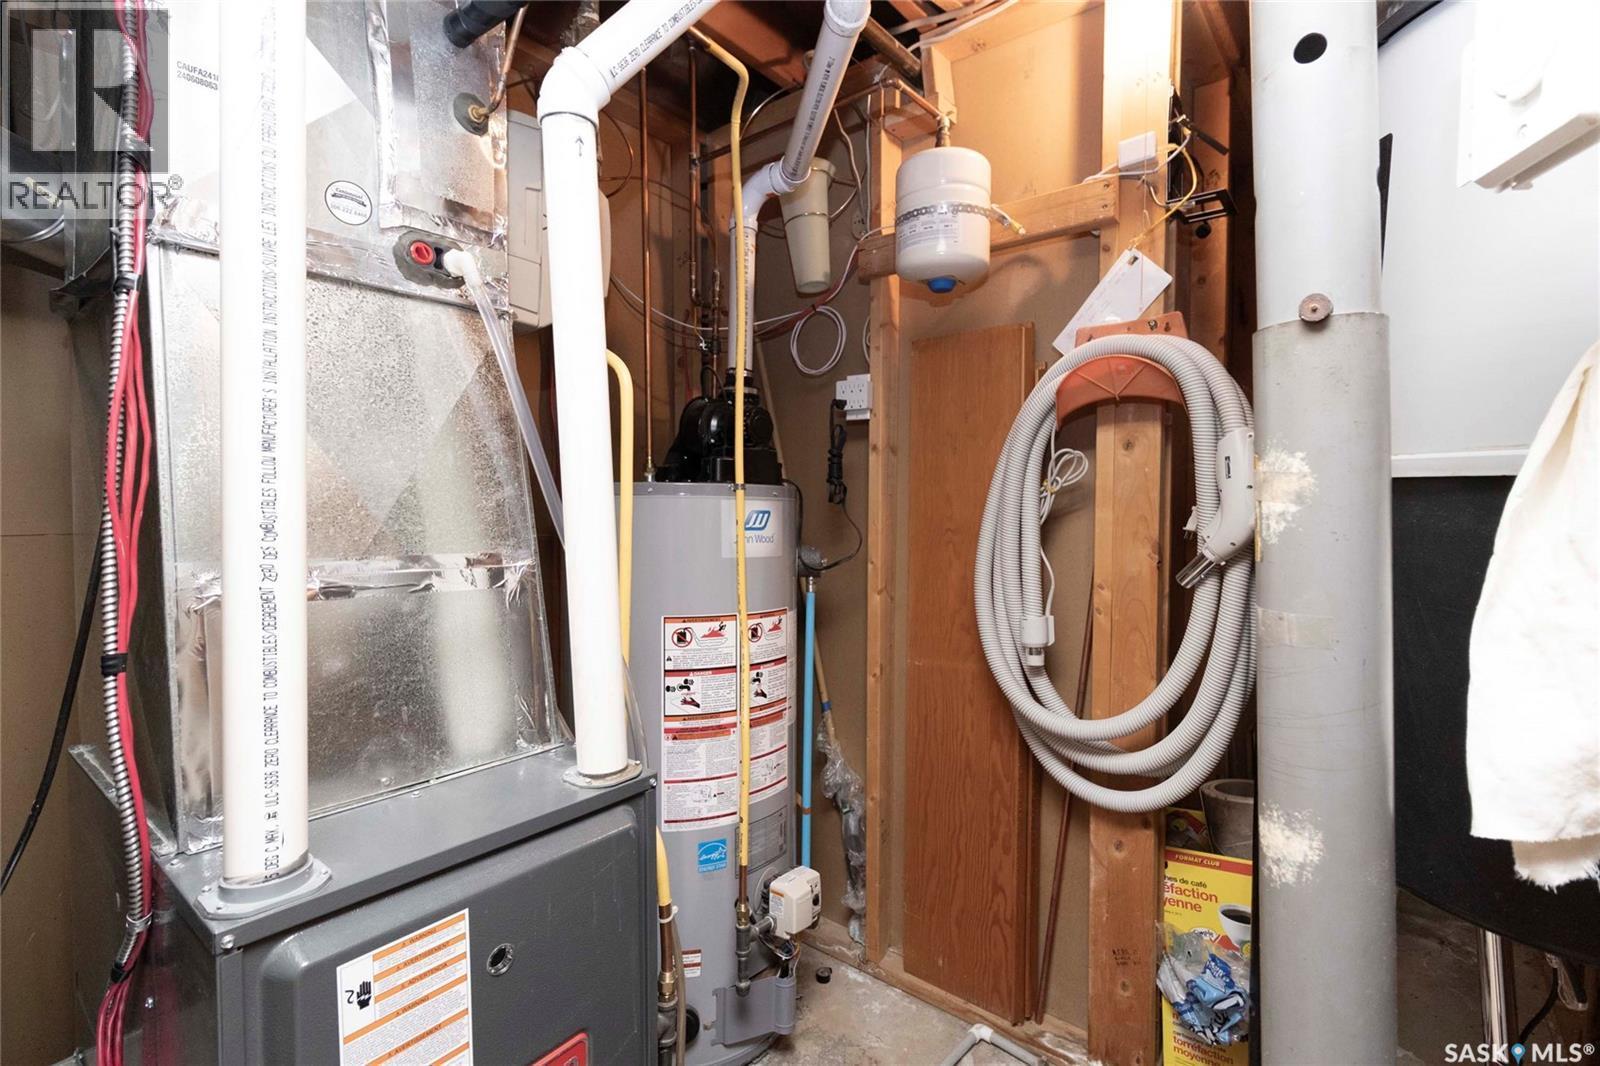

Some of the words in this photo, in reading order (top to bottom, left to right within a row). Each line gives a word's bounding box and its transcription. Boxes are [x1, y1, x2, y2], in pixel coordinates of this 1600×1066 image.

[261, 328, 278, 385] INSTALLATION
[260, 456, 278, 485] FOLLOW
[259, 488, 279, 543] COMBUSTIBLES
[260, 546, 278, 560] DES
[259, 564, 278, 582] ZERO
[262, 691, 279, 701] TO
[263, 705, 279, 746] CLEARANCE
[264, 748, 280, 767] ZERO
[1175, 854, 1202, 863] FORMAT
[1190, 880, 1208, 889] café
